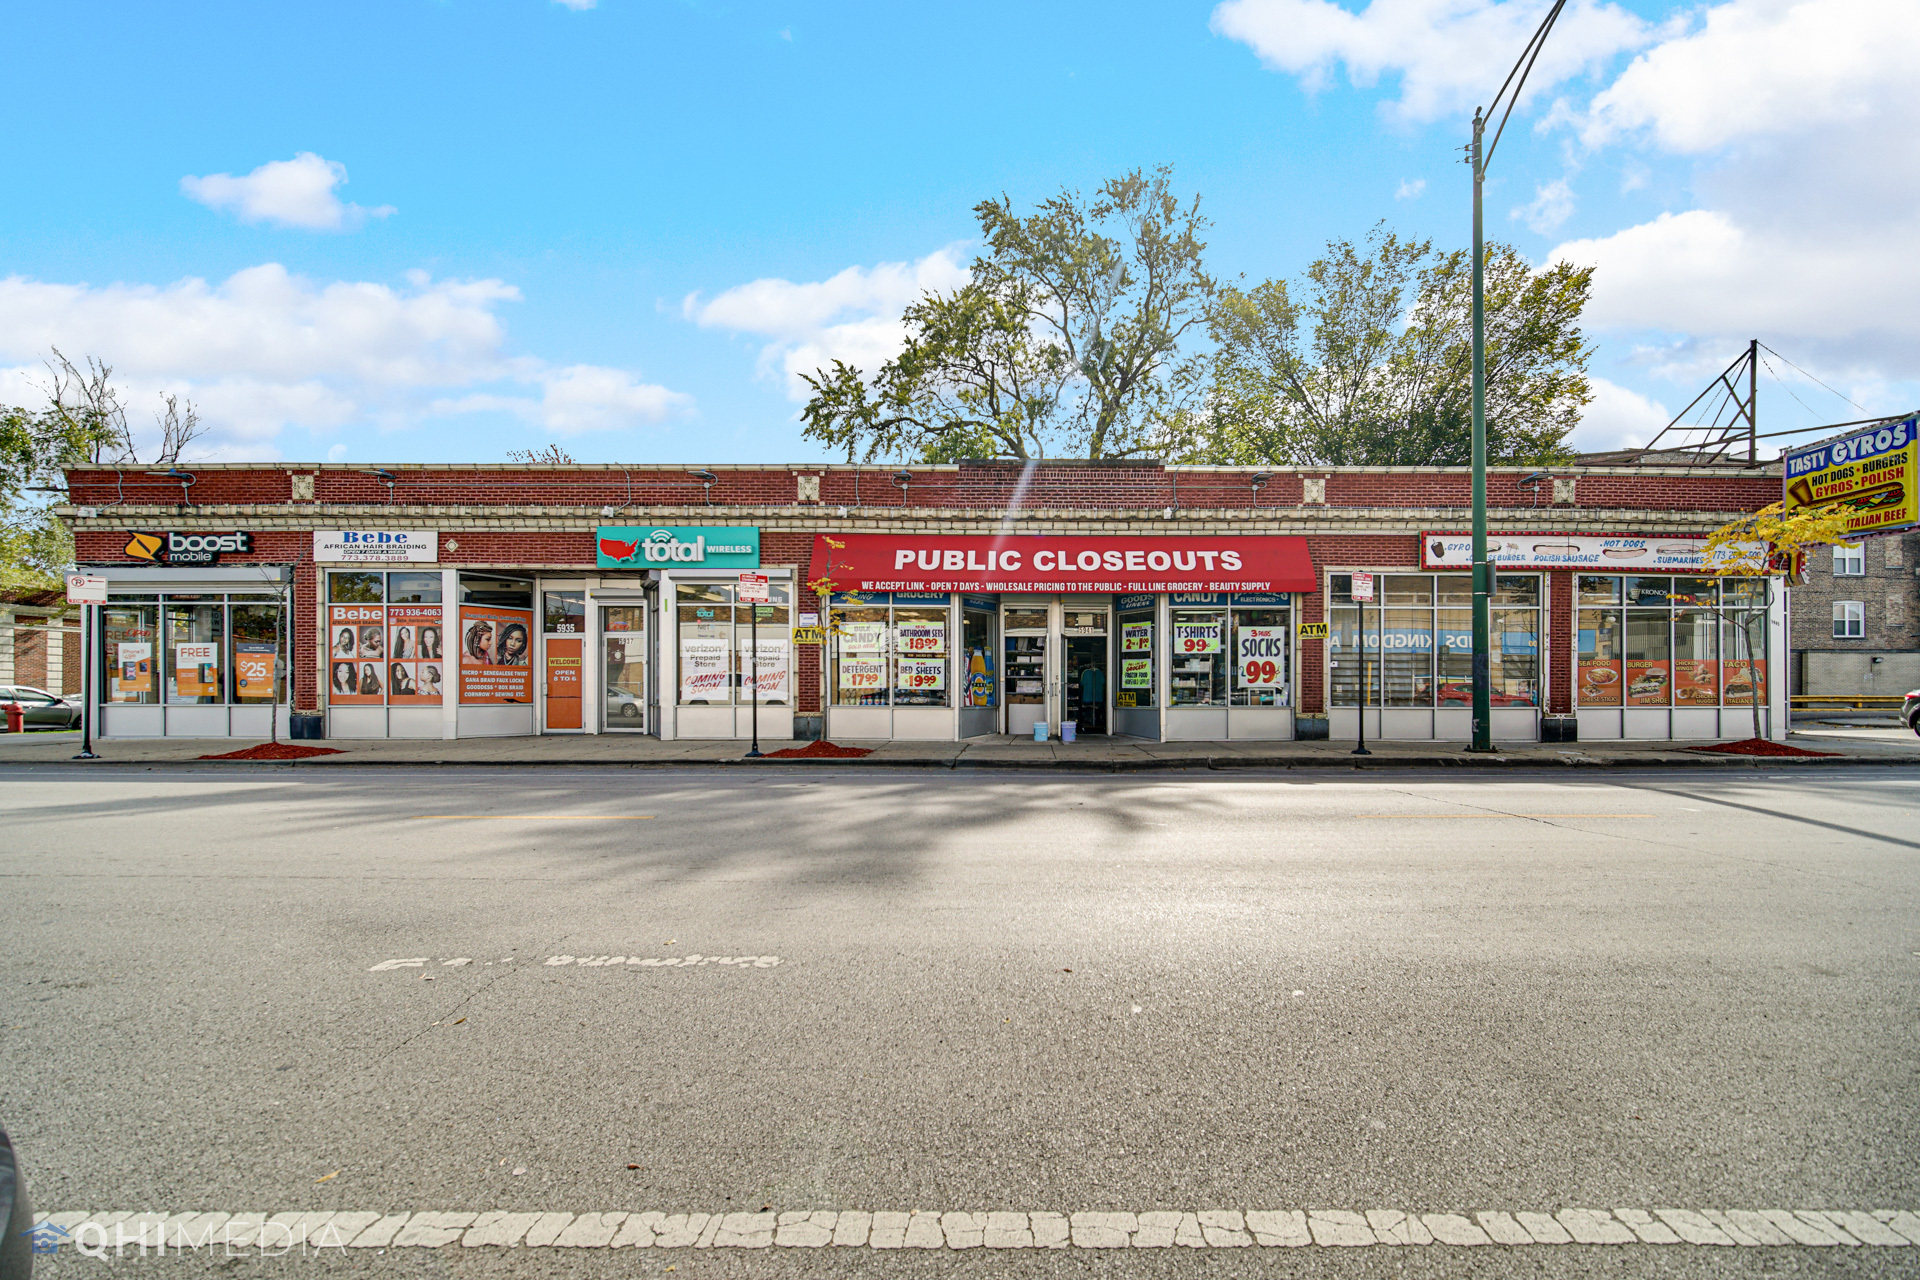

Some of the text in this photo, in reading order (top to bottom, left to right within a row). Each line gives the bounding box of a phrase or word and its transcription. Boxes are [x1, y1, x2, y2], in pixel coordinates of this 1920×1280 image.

[1789, 424, 1907, 475] TASTY GYROS
[1811, 451, 1909, 487] HOT DOGS BURGERS
[1815, 466, 1905, 498] GYROS POLISH
[1846, 508, 1908, 529] ITALIAN BEEF
[168, 532, 249, 551] boost
[343, 531, 408, 543] Bebe
[642, 536, 706, 562] total
[1622, 540, 1646, 548] DOGS
[706, 545, 753, 554] WIRELESS
[169, 551, 212, 561] mobile
[894, 549, 1243, 571] PUBLIC CLOSEOUTS
[1534, 554, 1561, 562] POLISH
[1562, 554, 1600, 563] SAUSAGE
[861, 581, 1271, 591] WE ACCEPT LINK OPEN 7 DAYS WHOLESALE PRICING TO THE PUBLIC FULL LINE GROCERY BEAUTY SUPPLY
[896, 591, 945, 599] GROCERY
[1121, 593, 1155, 604] GOODS
[1173, 592, 1218, 603] CANDY
[333, 606, 383, 620] Bebe
[389, 608, 442, 617] 773 936-4063
[696, 608, 714, 617] total
[556, 623, 576, 632] 5935
[1176, 625, 1219, 638] T-SHIRTS
[1300, 624, 1327, 635] ATM
[126, 628, 151, 638] Open
[794, 629, 822, 639] ATM
[843, 632, 880, 643] CANDY
[900, 629, 944, 637] BATHROOM SETS
[1125, 629, 1148, 638] WATER
[1250, 629, 1258, 637] 3
[685, 644, 722, 652] verizon
[1125, 638, 1132, 649] 2
[1241, 637, 1281, 657] SOCKS
[180, 647, 211, 658] FREE
[690, 654, 720, 662] Prepaid
[239, 660, 267, 677] $25
[694, 660, 716, 668] Store
[842, 664, 884, 673] DETERGENT
[900, 665, 942, 675] BED SHEETS
[684, 670, 727, 685] COMING
[690, 680, 721, 695] SOON
[1118, 693, 1135, 701] ATM
